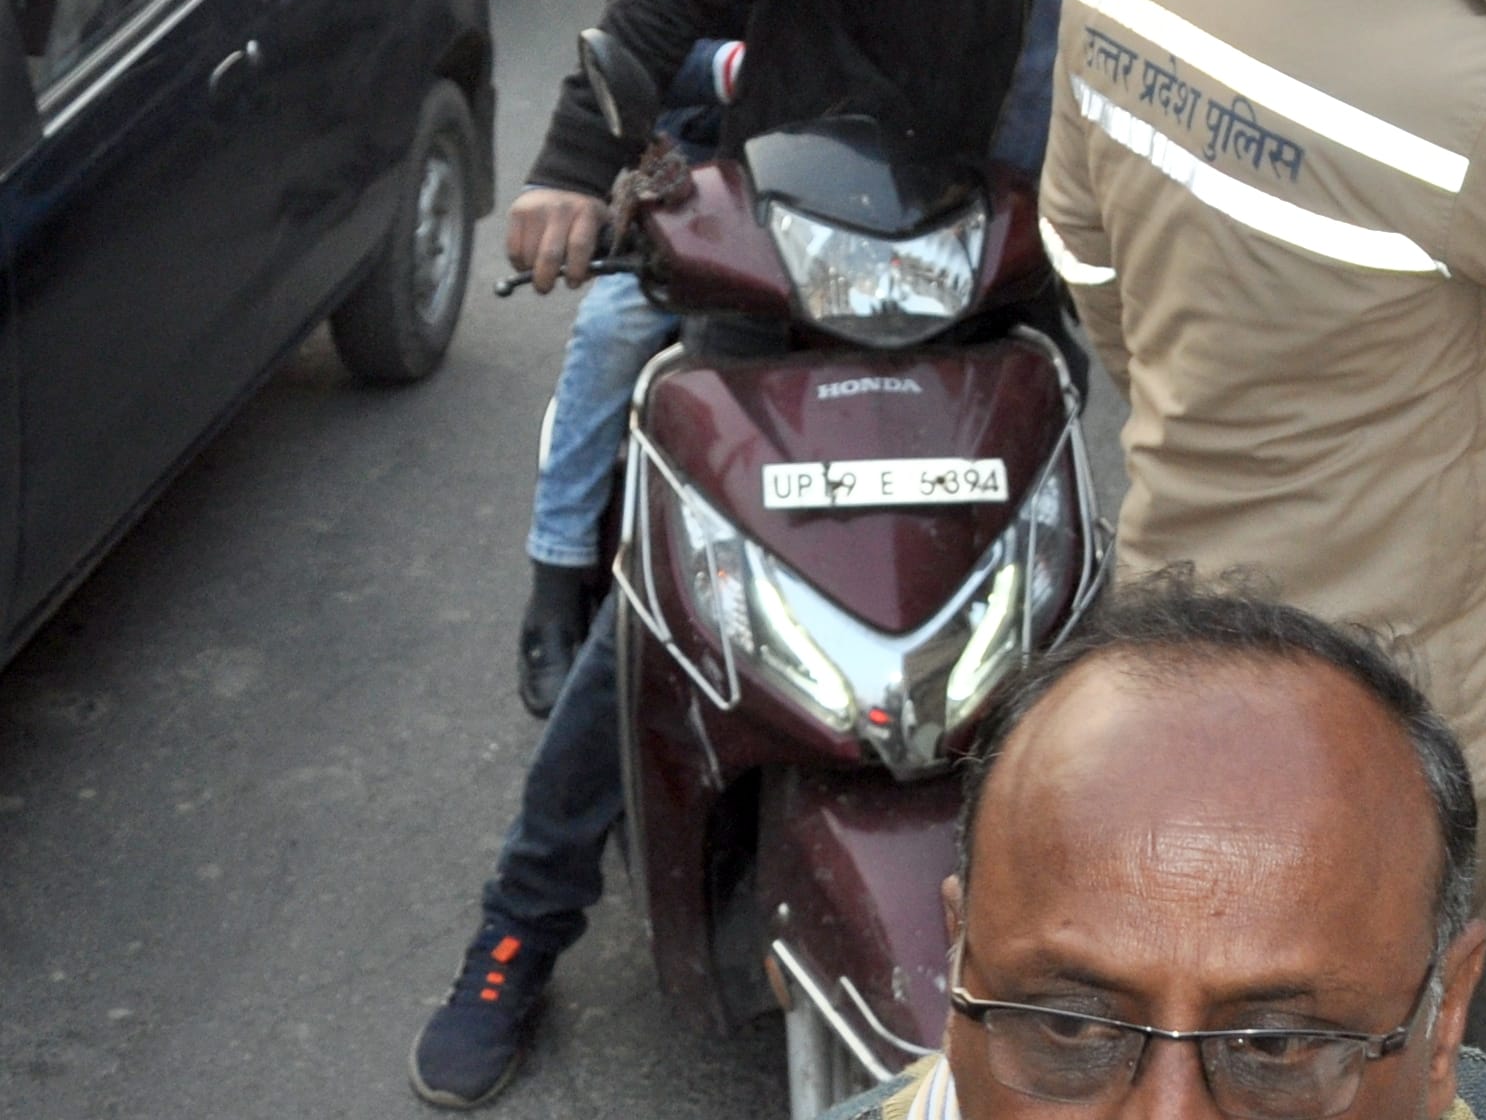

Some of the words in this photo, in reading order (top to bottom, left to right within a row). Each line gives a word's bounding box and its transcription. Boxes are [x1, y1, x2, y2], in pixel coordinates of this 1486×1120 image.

[1140, 54, 1202, 130] प्रदेश
[1205, 95, 1306, 183] पुलिस
[817, 376, 923, 399] HONDA
[880, 471, 895, 496] E
